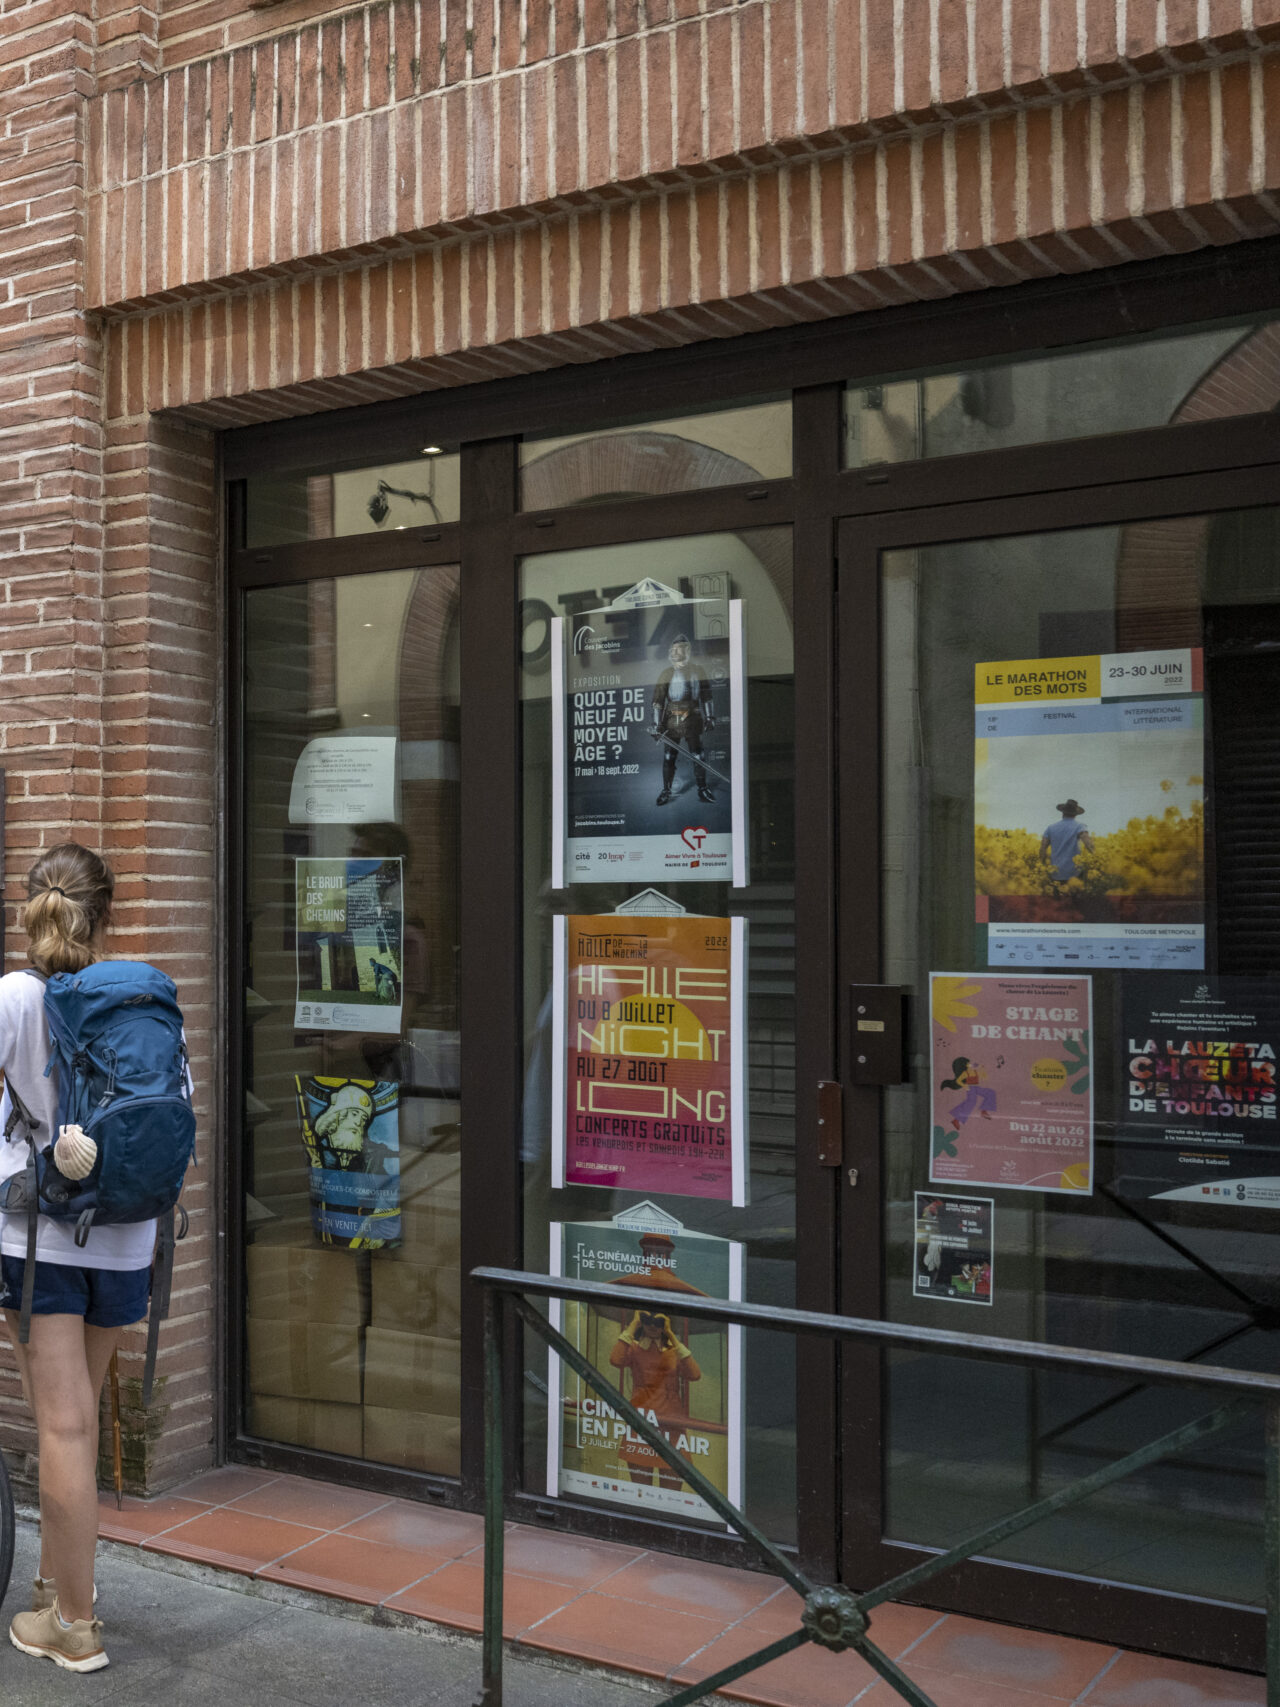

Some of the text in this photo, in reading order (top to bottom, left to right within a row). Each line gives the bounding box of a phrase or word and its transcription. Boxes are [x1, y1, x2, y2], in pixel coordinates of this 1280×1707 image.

[987, 670, 1087, 686] LE MARATHON
[1109, 663, 1182, 678] 23-30 JUIN
[573, 673, 621, 688] EXPOSITION
[1014, 682, 1087, 696] DES MOTS
[574, 688, 644, 709] QUOI DE
[574, 706, 644, 726] NEUF AU
[1124, 706, 1182, 715] INTERNATIONAL
[574, 726, 628, 745] MOYEN
[574, 742, 607, 762] ÂGE
[575, 764, 639, 777] 17 mai 18 sept. 2022
[306, 875, 344, 889] LE BRUIT
[306, 892, 323, 905] DES
[306, 908, 345, 922] CHEMINS
[705, 936, 728, 947] 2022
[577, 964, 727, 1001] HALLE
[577, 1000, 596, 1020] DU
[602, 1000, 610, 1021] 8
[1006, 1006, 1079, 1022] STAGE
[971, 1024, 1084, 1041] DE CHANT
[1128, 1038, 1276, 1059] LA LAUZETA
[577, 1056, 596, 1078] AU
[602, 1058, 621, 1080] 27
[1129, 1056, 1276, 1085] CHŒUR
[1129, 1080, 1277, 1103] D'ENFANTS
[576, 1080, 726, 1123] LONG
[1129, 1098, 1277, 1119] DE TOULOUSE
[1009, 1122, 1085, 1135] Du 22 au 26
[1020, 1133, 1084, 1147] août 2022
[335, 1220, 358, 1232] VENTE
[582, 1249, 677, 1269] LA CINÉMATHÈQUE
[582, 1259, 652, 1276] DE TOULOUSE
[582, 1417, 608, 1438] EN
[675, 1433, 710, 1456] AIR
[589, 1437, 619, 1450] JUILLET
[626, 1444, 636, 1453] 27
